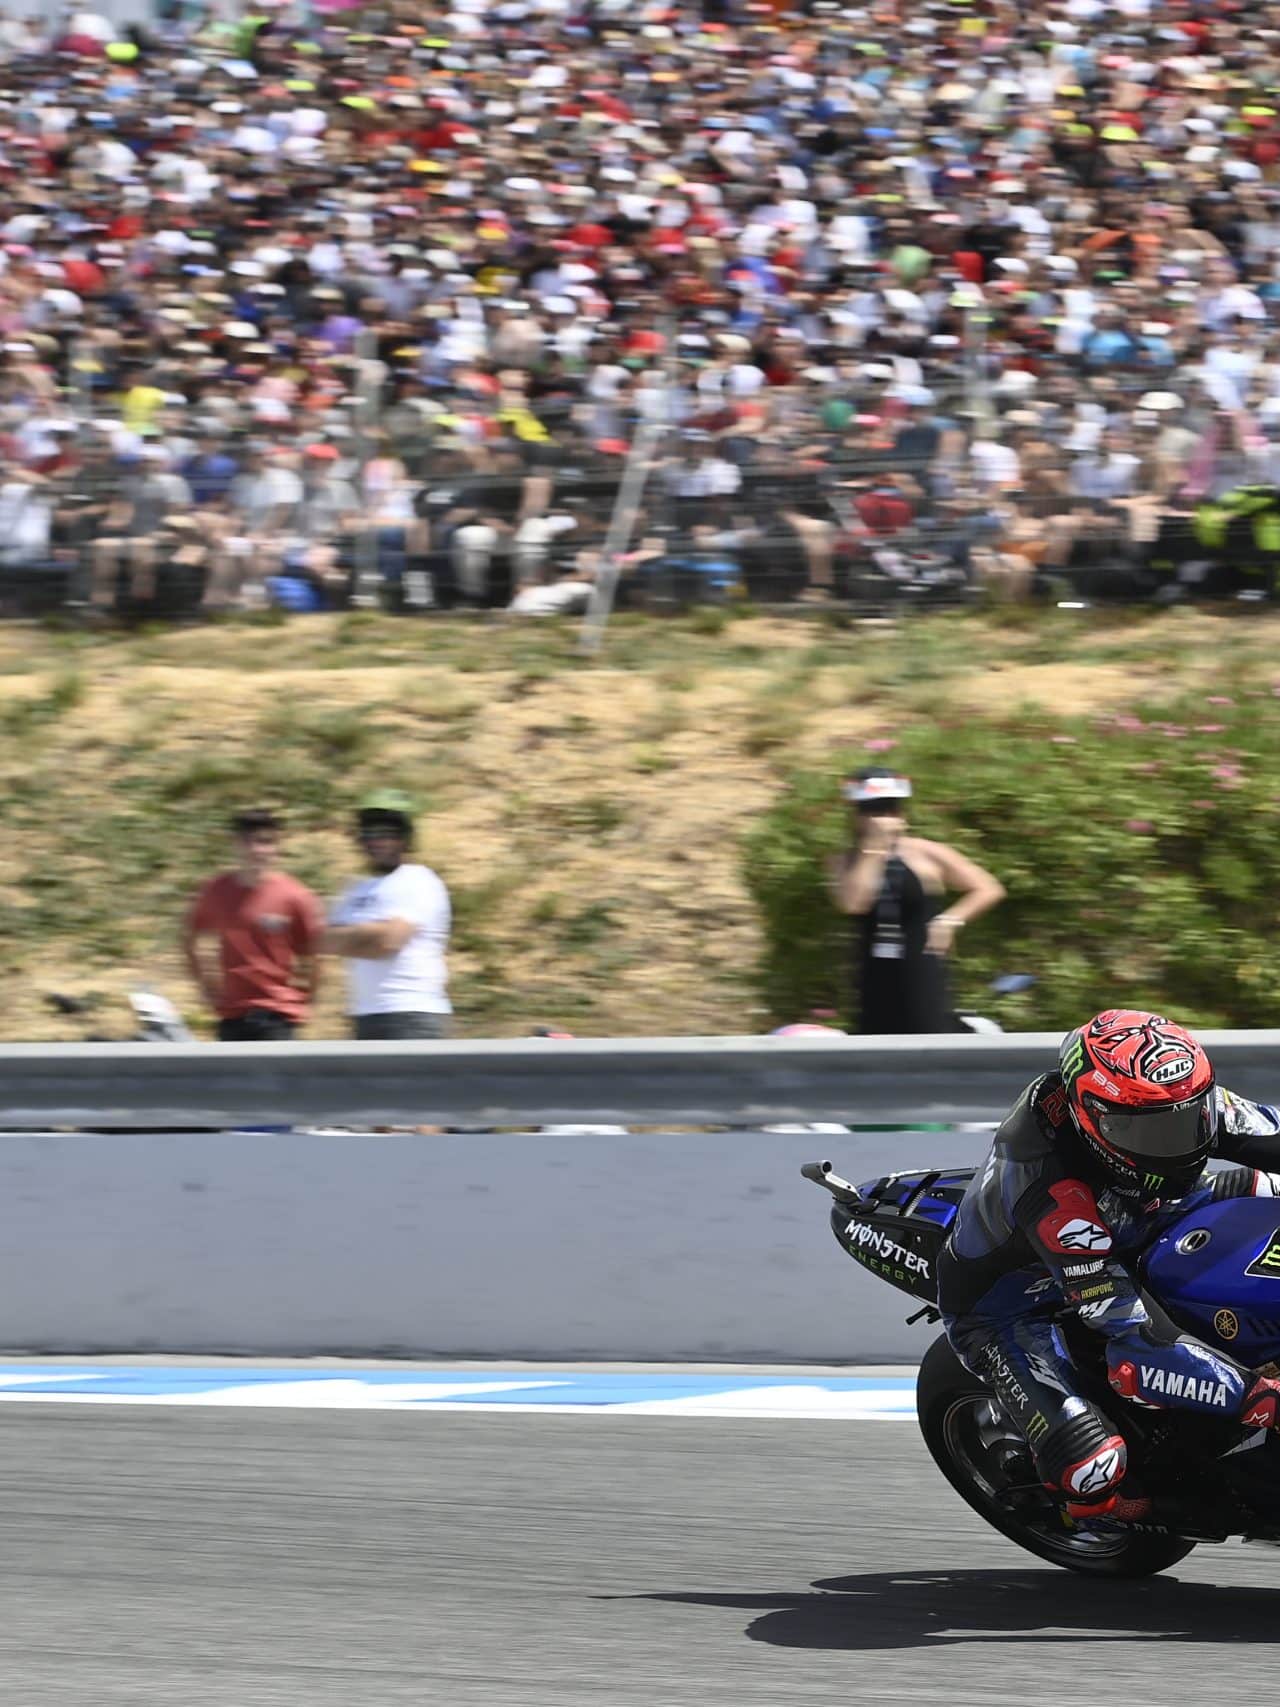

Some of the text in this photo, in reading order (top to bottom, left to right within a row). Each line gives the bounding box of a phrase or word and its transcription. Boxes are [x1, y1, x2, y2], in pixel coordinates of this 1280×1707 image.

[1155, 1059, 1191, 1081] HJC
[844, 1219, 930, 1279] MONSTER
[848, 1244, 918, 1284] ENERGY
[1141, 1365, 1227, 1408] YAMAHA
